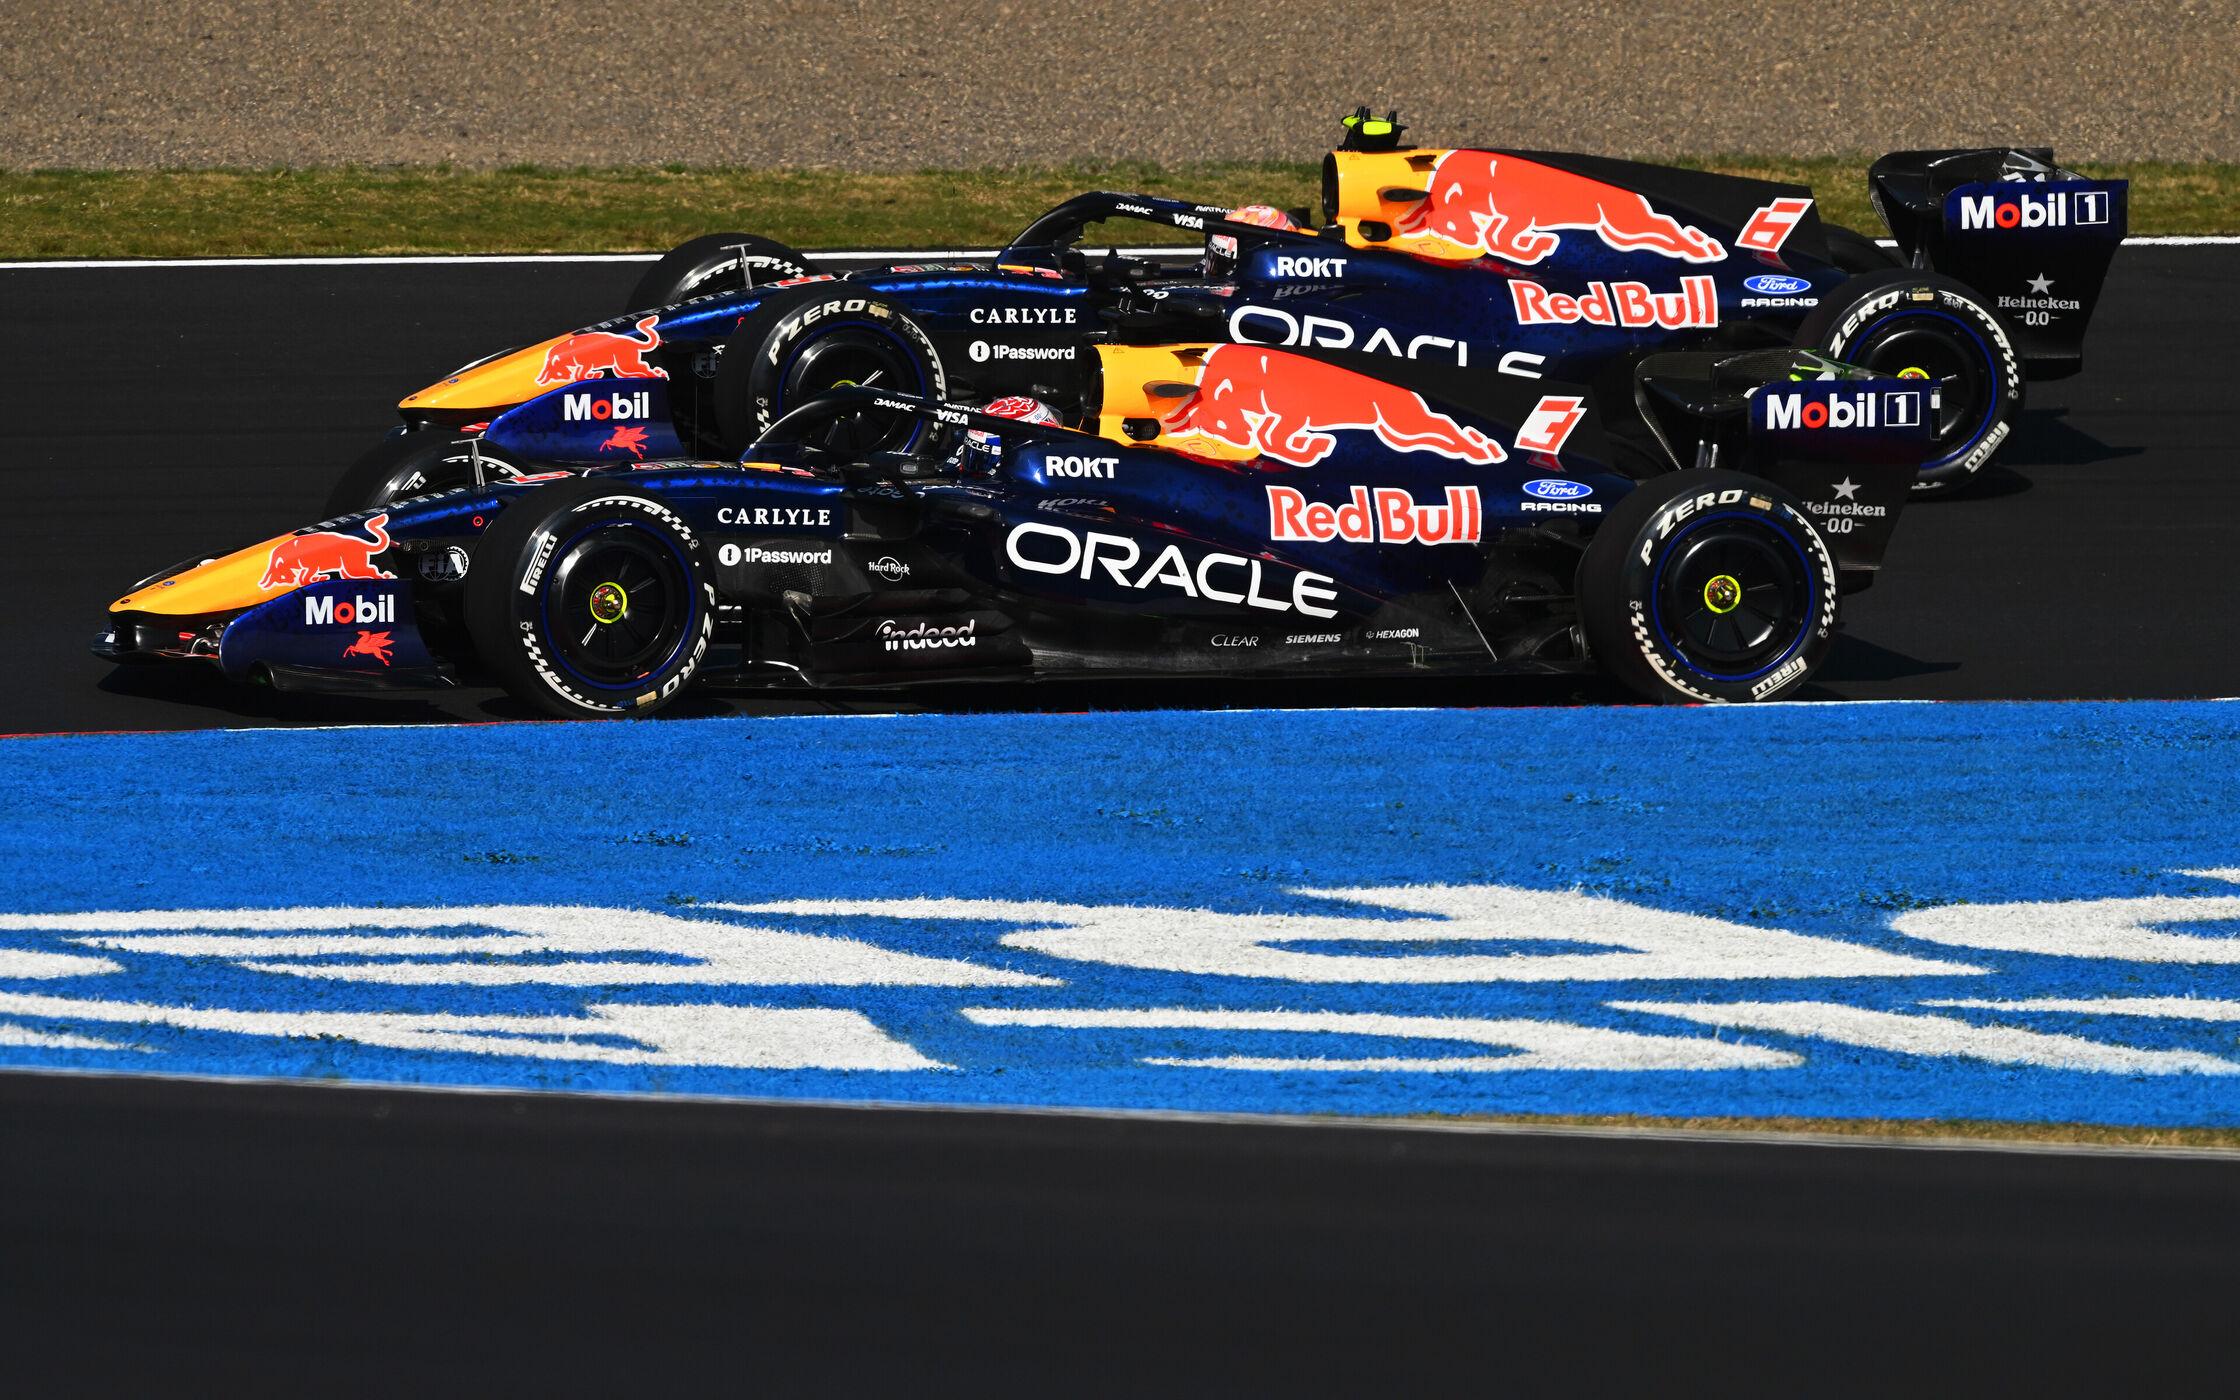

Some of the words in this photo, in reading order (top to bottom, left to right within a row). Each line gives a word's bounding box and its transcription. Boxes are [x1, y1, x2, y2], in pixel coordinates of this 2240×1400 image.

[1115, 203, 1153, 215] DAMAC
[1960, 193, 2067, 230] Mobil
[1172, 213, 1204, 230] VISA
[1735, 198, 1814, 254] 6
[1277, 256, 1348, 278] ROKT
[1757, 276, 1798, 293] Ford
[1507, 278, 1616, 327] Red
[1611, 275, 1719, 331] Bull
[1741, 298, 1819, 308] RACING
[1998, 295, 2081, 311] Heineken
[969, 308, 1077, 324] CARLYLE
[1829, 290, 1900, 359] ZERO
[768, 340, 781, 366] P
[786, 299, 867, 342] ZERO
[993, 344, 1076, 360] 1Password
[563, 392, 650, 421] Mobil
[873, 398, 916, 412] DAMAC
[1766, 393, 1876, 430] Mobil
[935, 408, 969, 426] VISA
[1514, 396, 1588, 455] 3
[964, 436, 990, 453] RACLE
[1964, 420, 2010, 473] PIRELLI
[1045, 456, 1120, 479] ROKT
[1537, 482, 1579, 496] Ford
[717, 508, 831, 526] CARLYLE
[1265, 485, 1373, 543] Red
[1373, 486, 1483, 546] Bull
[1521, 502, 1602, 513] RACING
[1640, 539, 1653, 566] P
[1656, 489, 1743, 540] ZERO
[520, 531, 557, 596] PIRELLI
[743, 547, 832, 565] 1Password
[868, 561, 889, 572] Hard
[890, 563, 910, 575] Rock
[1005, 521, 1339, 619] ORACLE
[703, 582, 715, 606] P
[305, 594, 395, 626] Mobil
[876, 619, 976, 651] indeed
[1211, 634, 1259, 647] CLEAR
[1285, 633, 1342, 644] SIEMENS
[1376, 628, 1420, 639] HEXAGON
[662, 612, 714, 698] ZERO
[1751, 656, 1808, 701] PIRELLI
